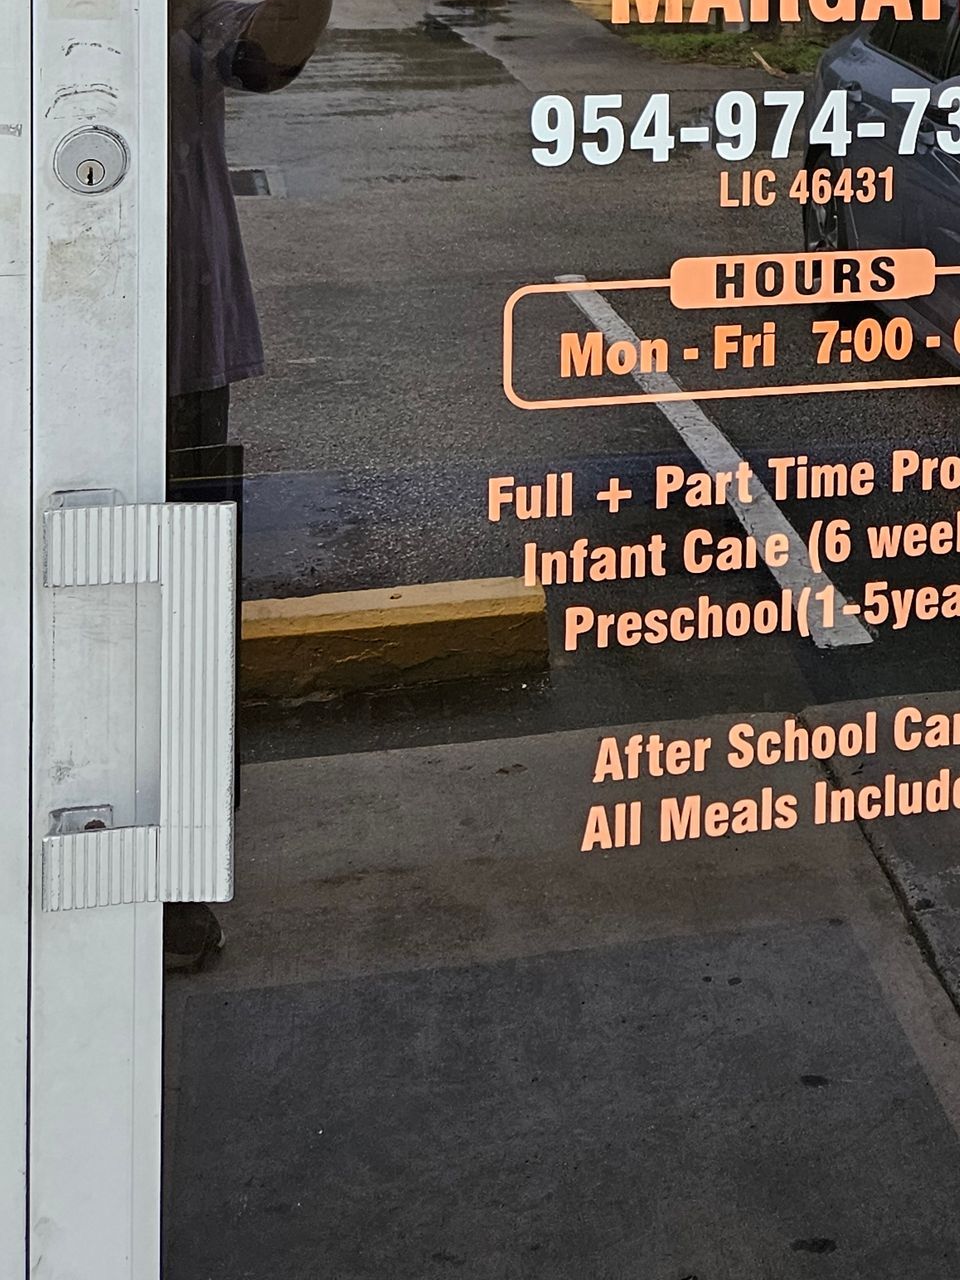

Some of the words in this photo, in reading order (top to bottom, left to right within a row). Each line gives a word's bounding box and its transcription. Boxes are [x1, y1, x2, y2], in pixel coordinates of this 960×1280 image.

[720, 170, 776, 207] LIC
[789, 167, 895, 205] 46431
[715, 256, 896, 299] HOURS
[560, 331, 669, 377] Mon
[714, 321, 776, 370] Fri
[812, 317, 913, 364] 7:00
[488, 472, 573, 522] Full
[597, 478, 632, 513] +
[656, 462, 753, 509] Part
[768, 455, 875, 501] Time
[523, 534, 666, 587] Infant
[683, 528, 789, 574] Care
[808, 519, 851, 573] (6
[593, 734, 712, 783] After
[727, 711, 877, 768] School
[581, 801, 642, 852] All
[660, 787, 798, 842] Meals
